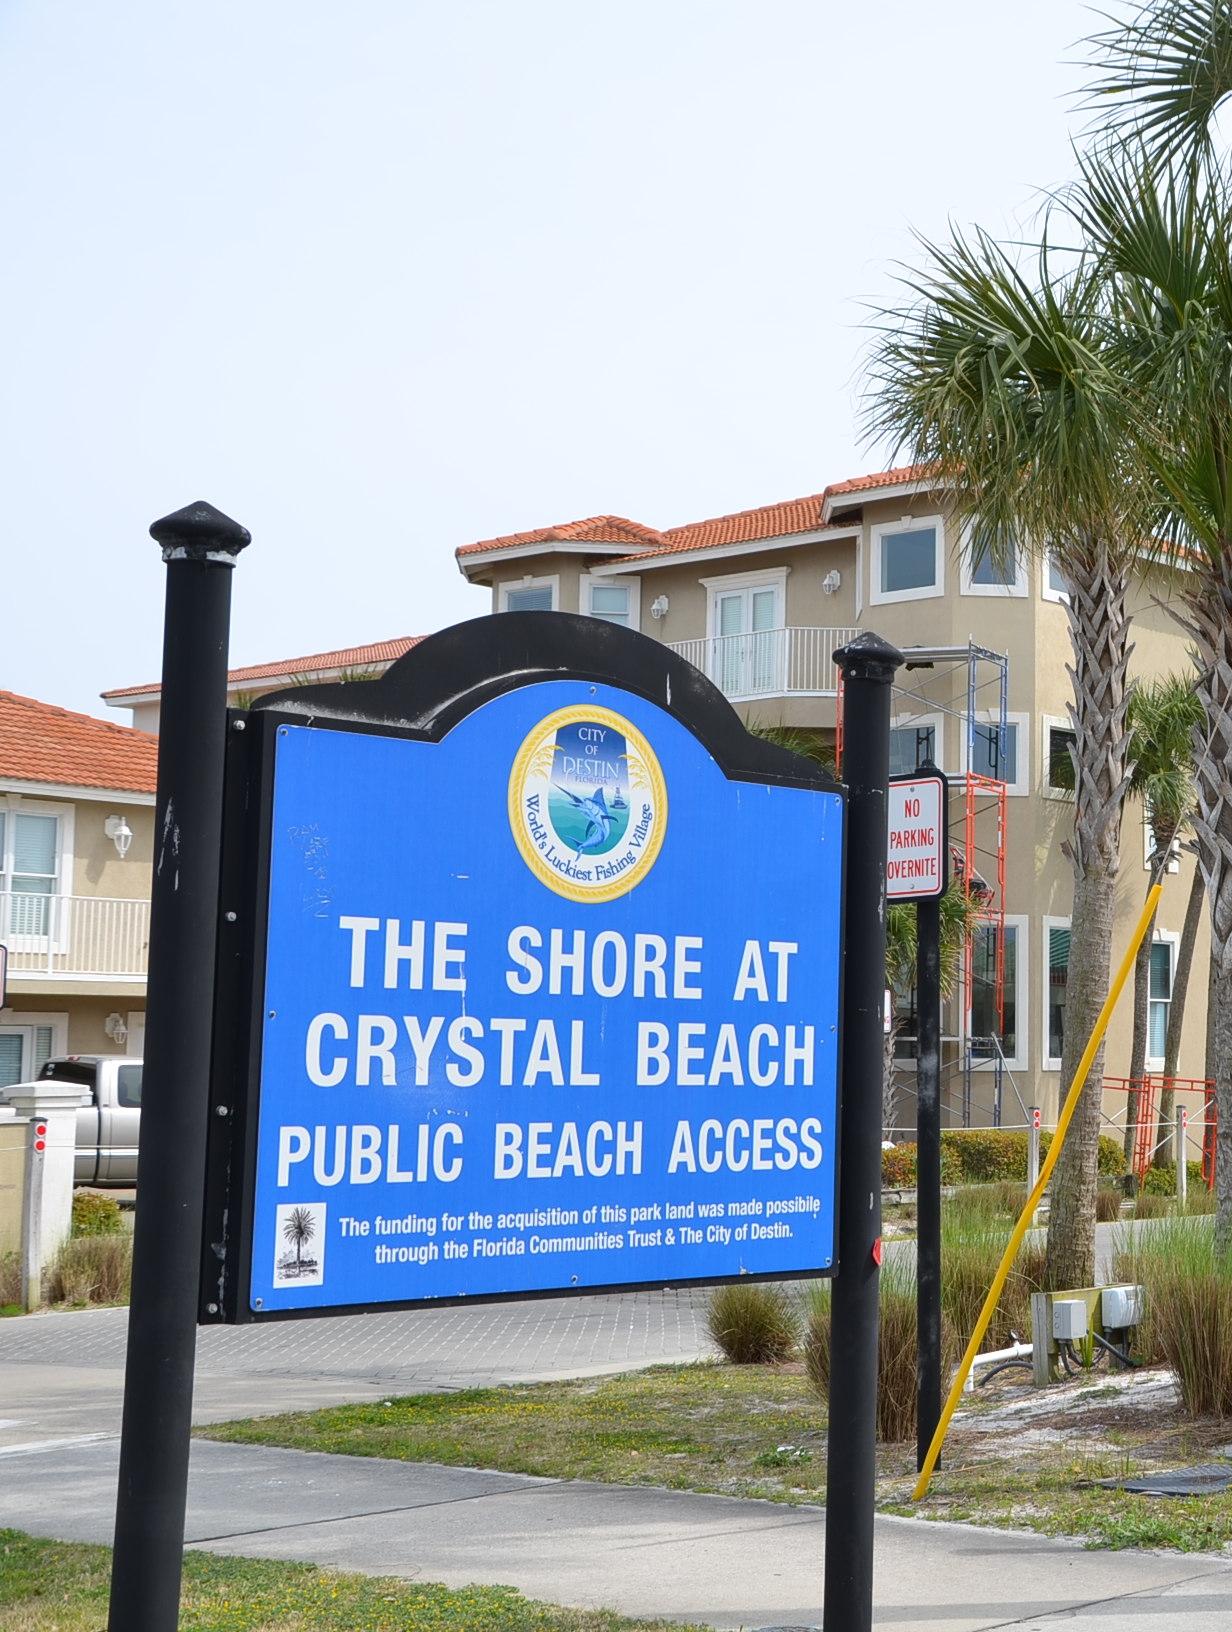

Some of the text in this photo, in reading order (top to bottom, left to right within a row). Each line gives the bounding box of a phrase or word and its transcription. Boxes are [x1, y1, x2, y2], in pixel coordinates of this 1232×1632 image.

[578, 727, 607, 743] CITY
[585, 745, 599, 756] OF
[563, 756, 619, 780] DESTIN
[575, 776, 608, 786] FLORIDA
[904, 798, 920, 818] NO
[526, 793, 653, 881] World's Luckiest Fishing Village
[890, 827, 934, 850] PARKING
[887, 857, 937, 880] OVERNITE
[339, 915, 798, 1003] THE SHORE AT
[305, 1013, 815, 1086] CRYSTAL BEACH
[276, 1117, 823, 1187] PUBLIC BEACH ACCESS
[339, 1217, 370, 1237] The
[374, 1214, 437, 1236] funding
[442, 1212, 464, 1232] for
[468, 1211, 493, 1230] the
[497, 1207, 578, 1231] acquisition
[582, 1205, 598, 1224] of
[600, 1205, 627, 1223] this
[630, 1202, 662, 1225] park
[665, 1200, 694, 1220] land
[697, 1203, 725, 1218] was
[727, 1198, 763, 1216] made
[374, 1221, 794, 1265] through the Florida Communities Trust & The City of Destin.
